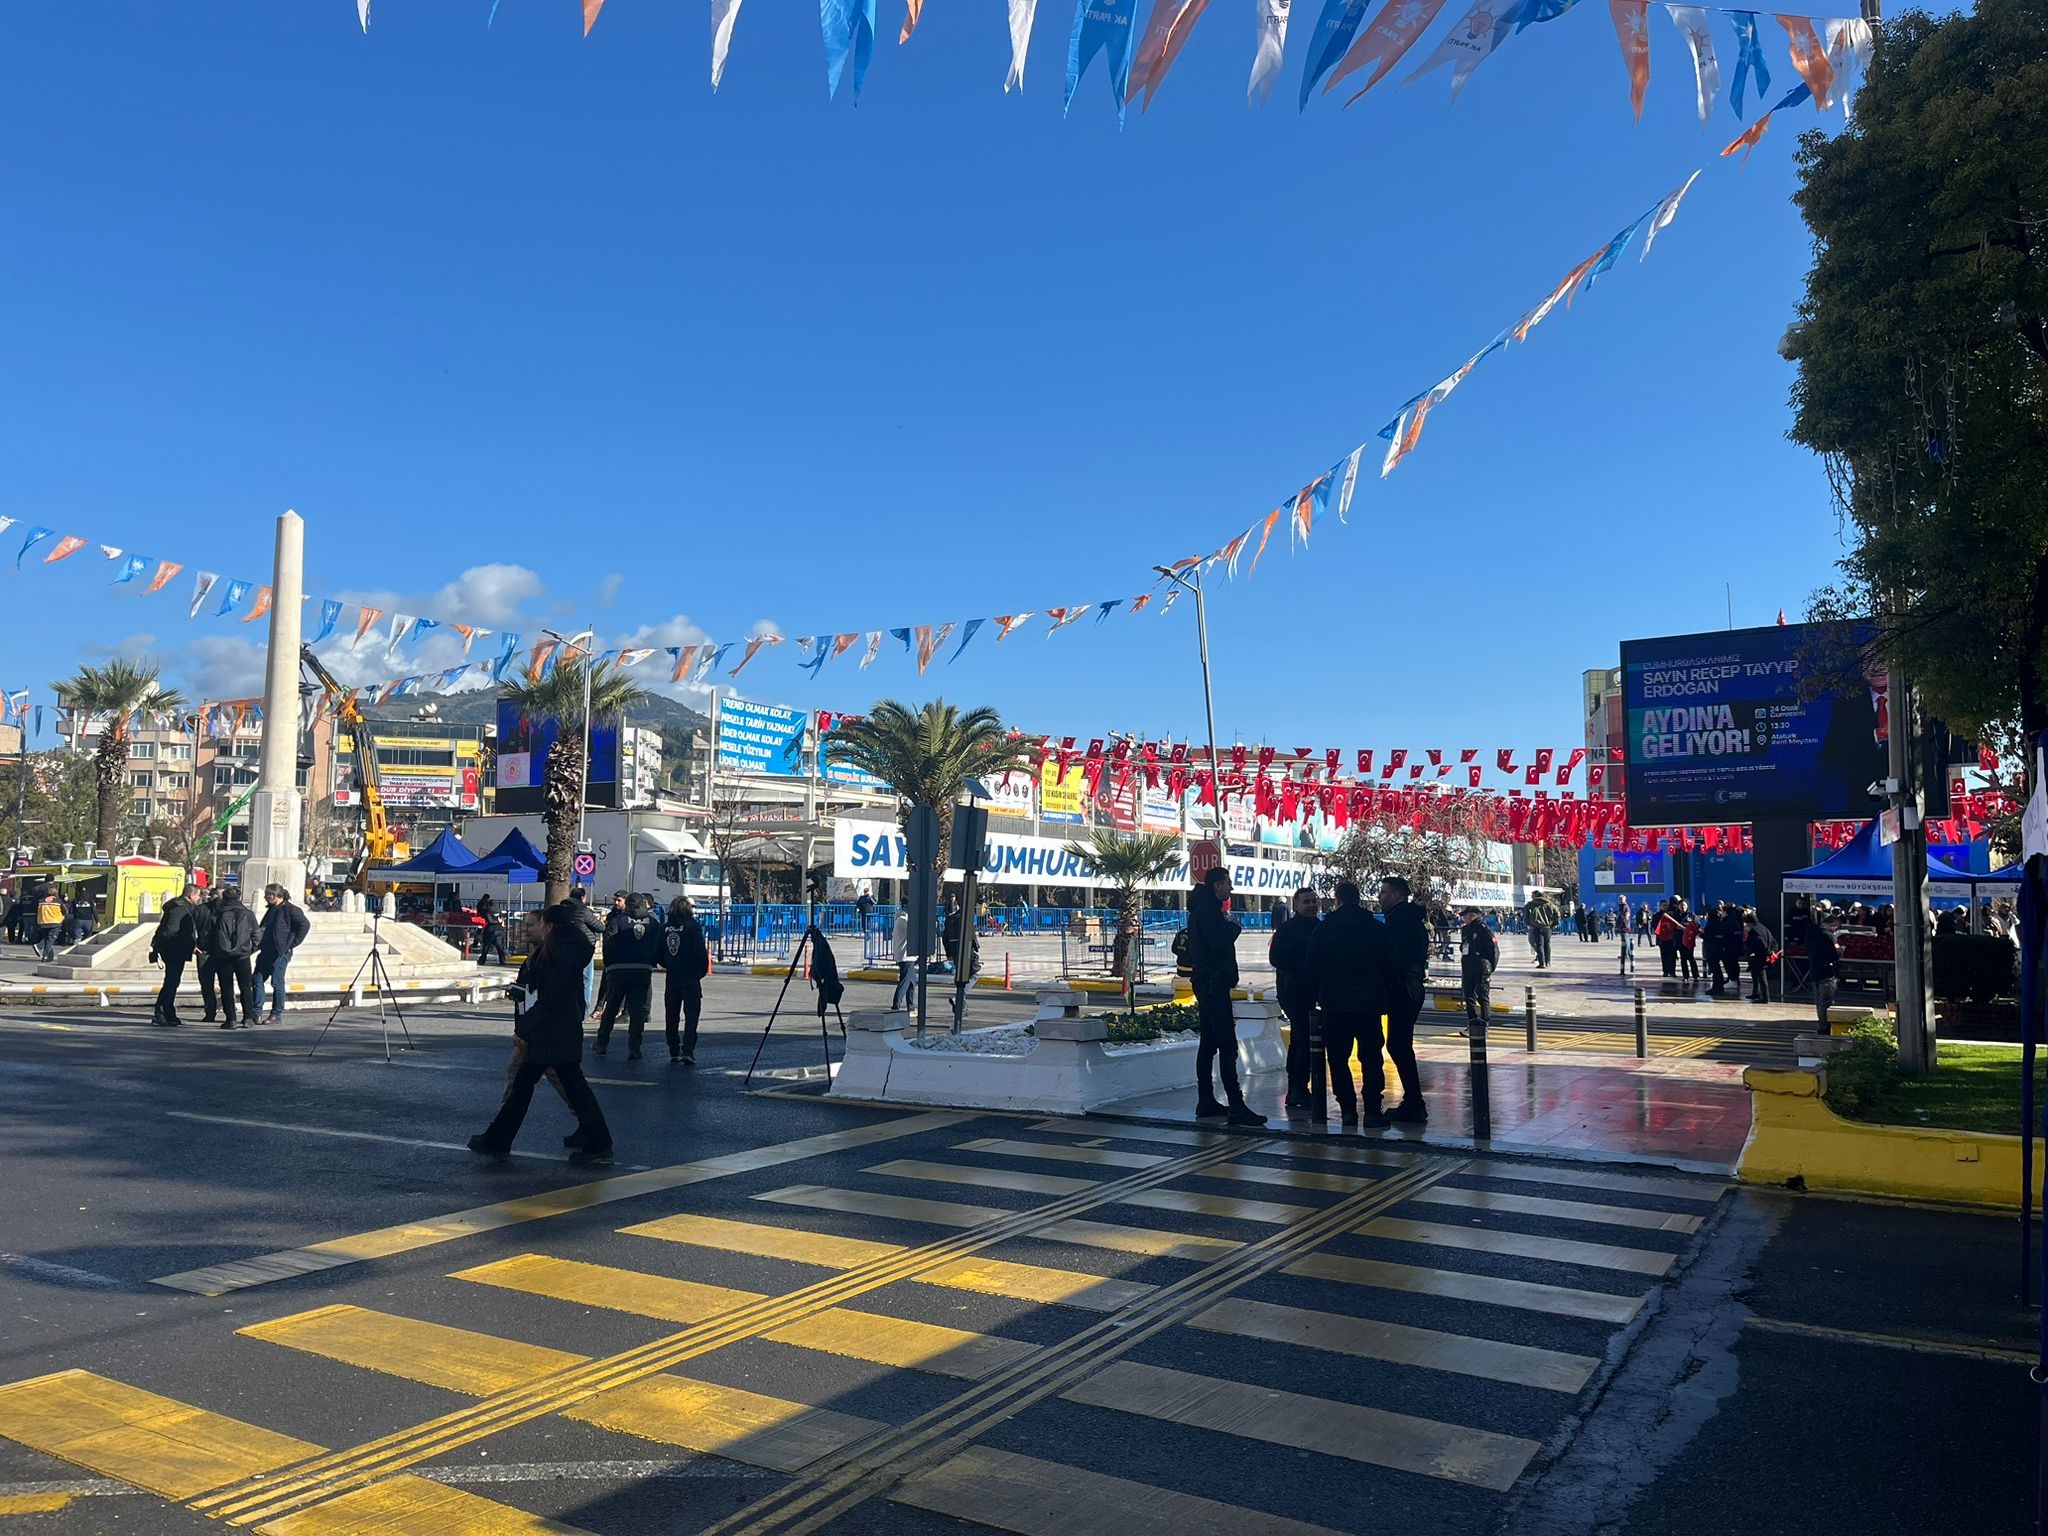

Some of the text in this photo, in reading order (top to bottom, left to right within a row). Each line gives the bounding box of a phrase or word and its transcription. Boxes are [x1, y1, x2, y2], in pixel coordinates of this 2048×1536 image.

[1643, 670, 1687, 685] SAYIN
[1690, 665, 1740, 681] RECEP
[745, 703, 769, 715] OLMAK
[1642, 704, 1735, 734] AYDIN'A
[738, 730, 760, 742] OLMAK
[851, 833, 906, 868] SAY
[1193, 854, 1219, 871] DUR
